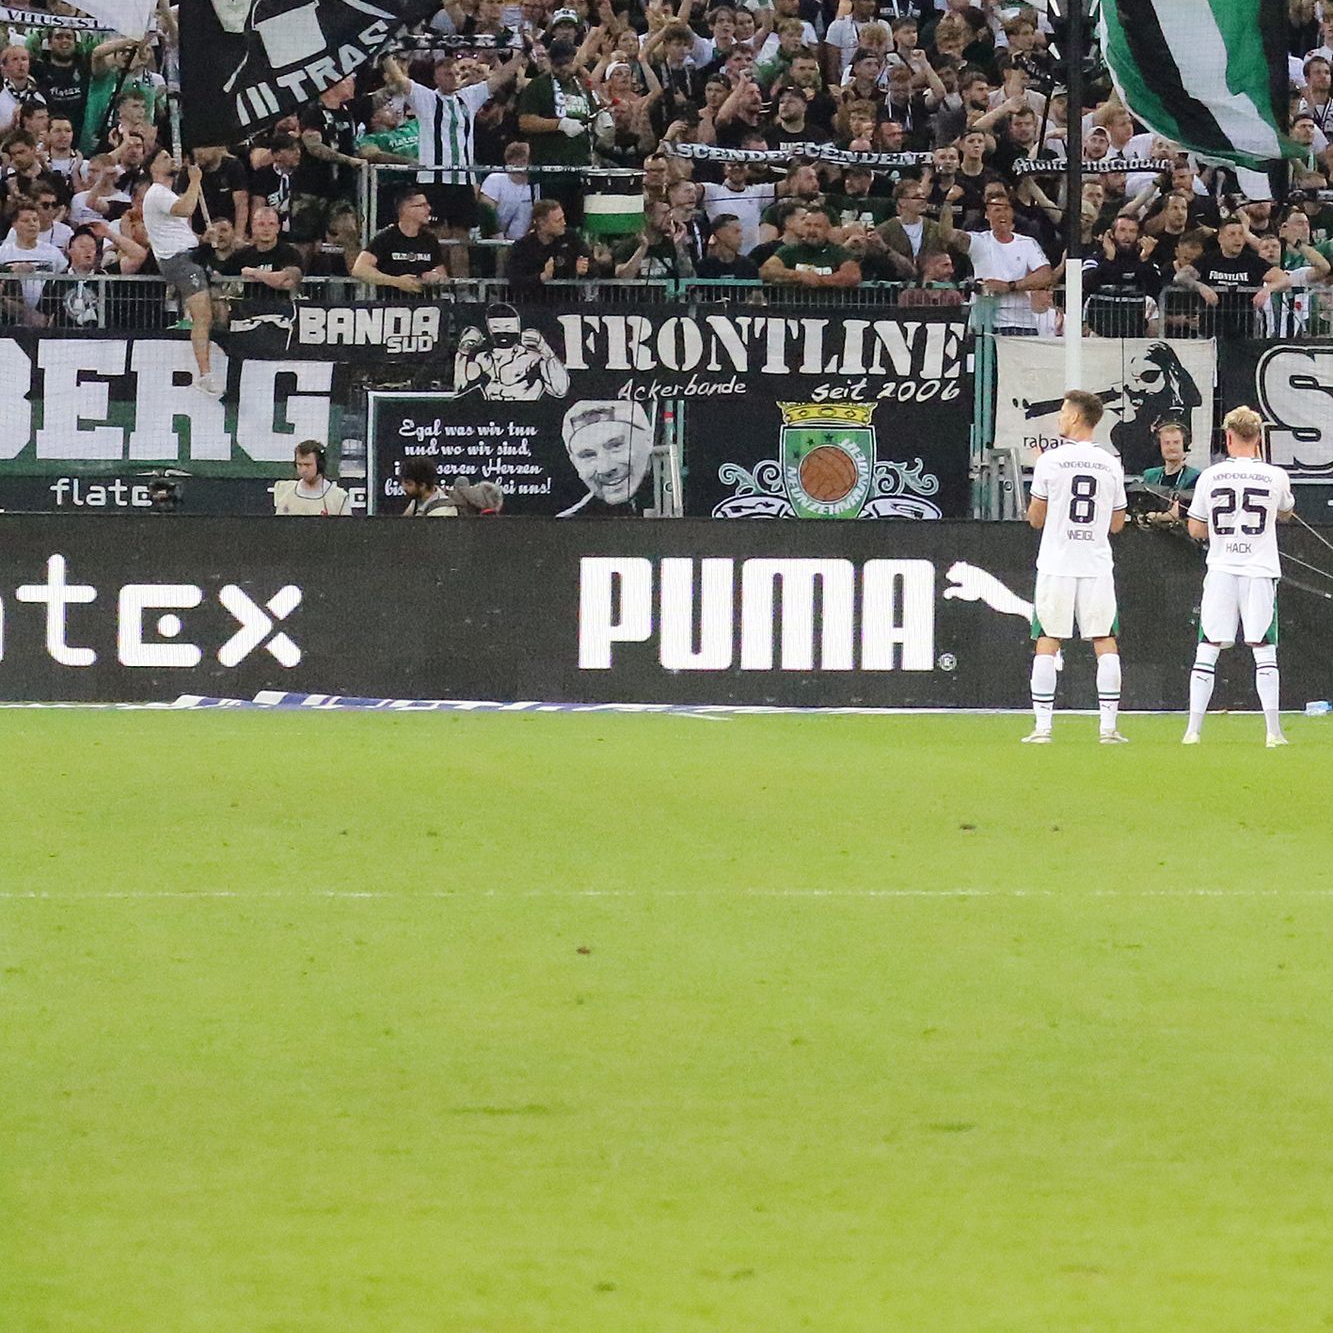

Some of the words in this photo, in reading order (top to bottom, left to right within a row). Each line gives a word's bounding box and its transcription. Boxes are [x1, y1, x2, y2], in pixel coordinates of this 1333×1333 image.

[299, 306, 441, 347] BANDA
[557, 312, 969, 380] FRONTLINE
[811, 376, 868, 402] seit
[877, 378, 962, 403] 2006
[399, 418, 443, 439] Egal
[445, 424, 474, 437] was
[477, 422, 505, 438] wir
[404, 440, 438, 457] und
[440, 444, 462, 457] wo
[464, 441, 493, 456] wir
[495, 442, 533, 459] sind,
[435, 461, 479, 476] seren
[482, 458, 543, 477] Herzen
[521, 478, 552, 496] uns!
[1069, 474, 1098, 524] 8
[1210, 487, 1271, 536] 25
[1066, 529, 1096, 543] WEIGL
[1226, 541, 1253, 554] HACK
[0, 553, 303, 670] tex
[577, 557, 939, 671] PUMA
